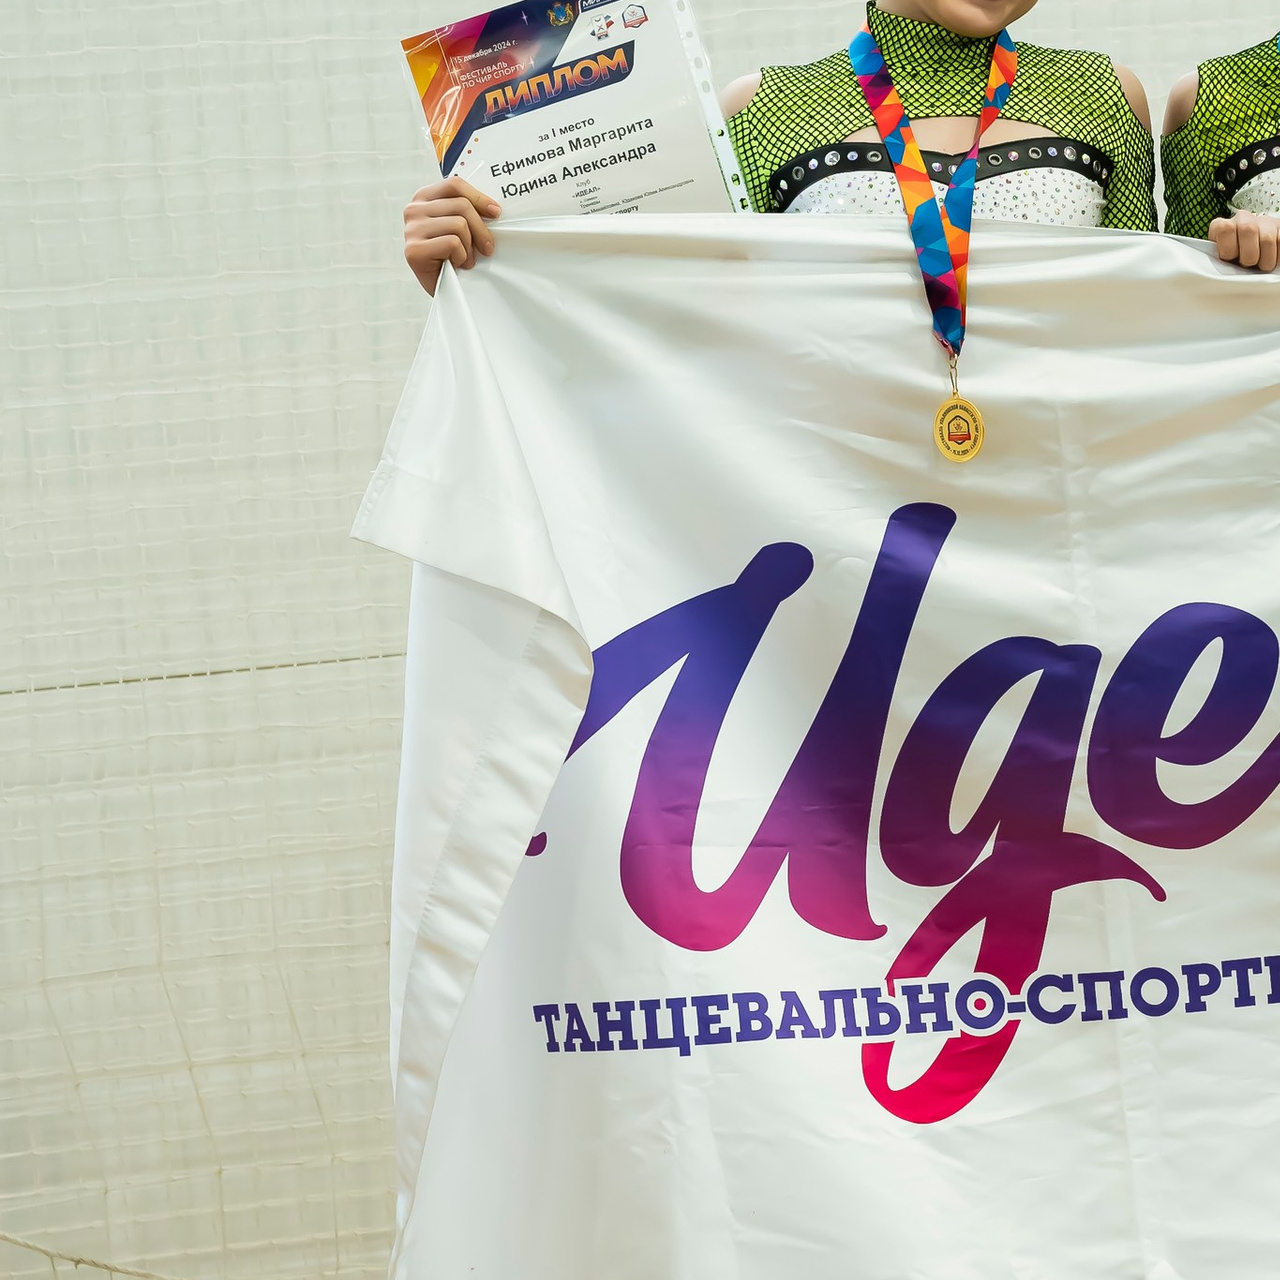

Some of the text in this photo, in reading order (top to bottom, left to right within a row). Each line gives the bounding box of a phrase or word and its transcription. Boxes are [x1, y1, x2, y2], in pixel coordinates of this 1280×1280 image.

[453, 55, 464, 65] 15
[463, 48, 493, 63] декабря
[493, 40, 511, 52] 2024
[460, 60, 508, 82] ФЕСТИВАЛЬ
[462, 63, 525, 90] ПО ЧИР СПОРТУ
[483, 48, 629, 123] ДИПЛОМ
[538, 133, 550, 143] за
[559, 117, 595, 136] место
[490, 118, 654, 178] Ефимова Маргарита
[501, 142, 657, 199] Юдина Александра
